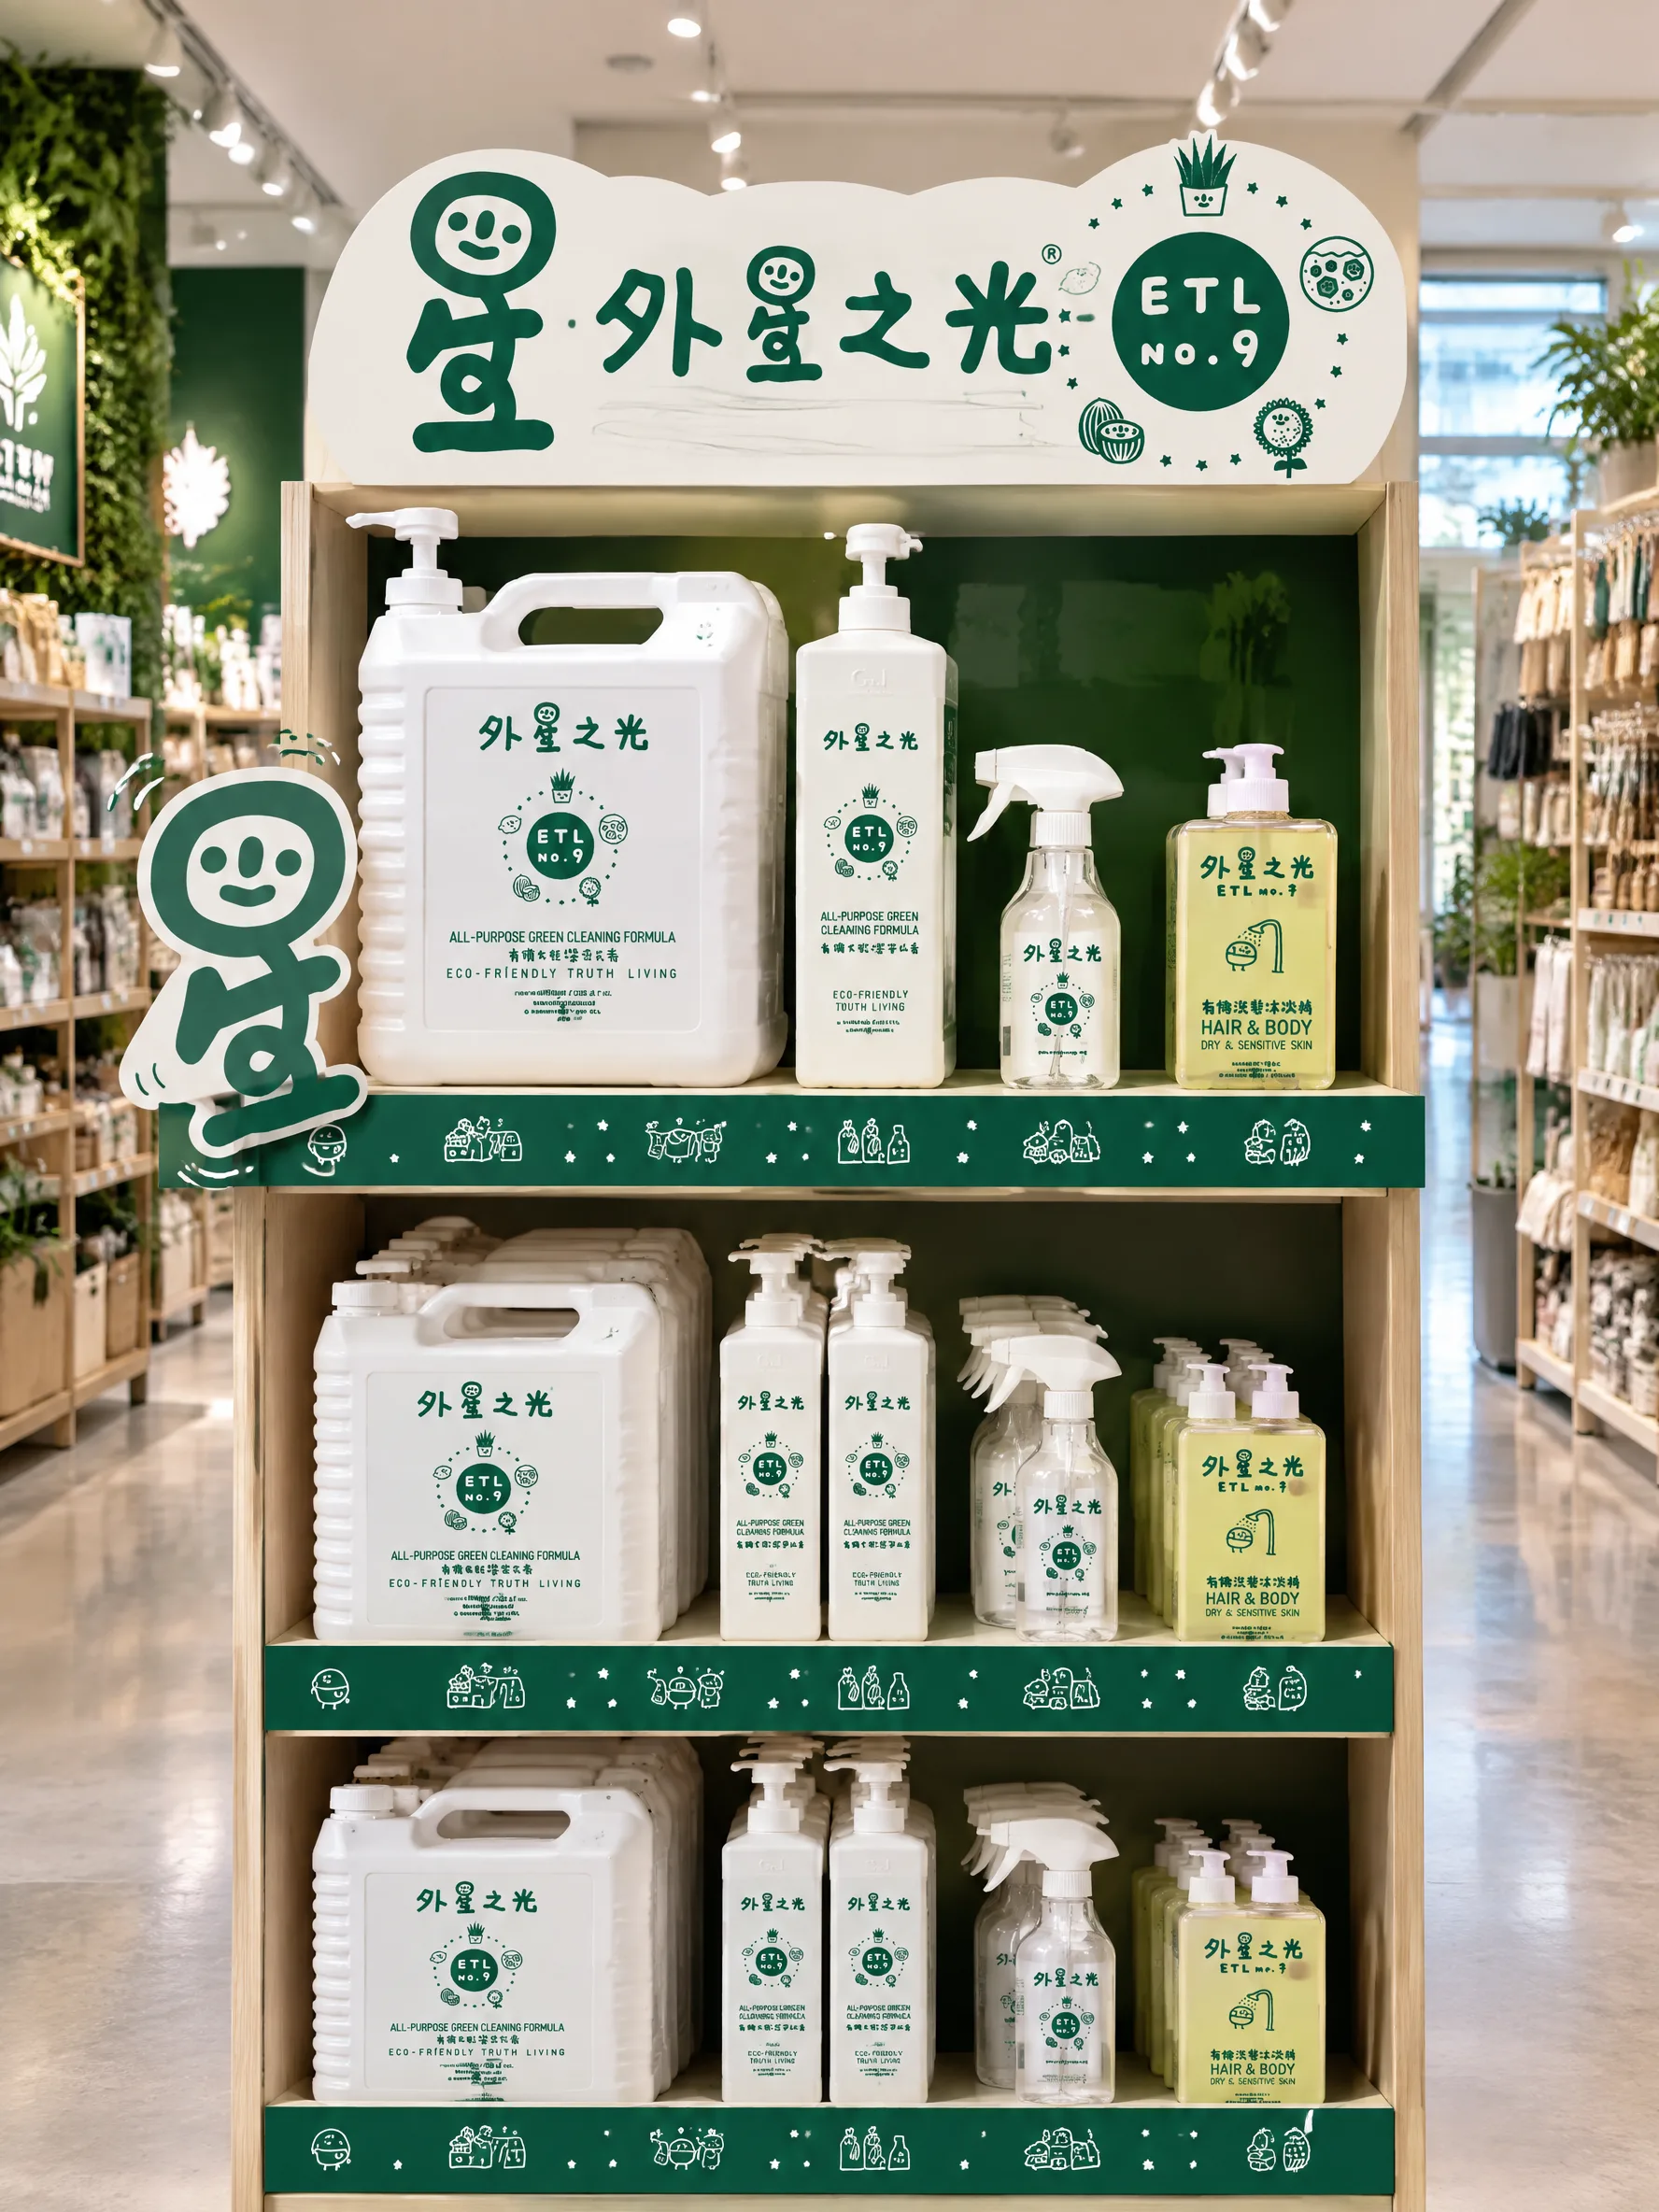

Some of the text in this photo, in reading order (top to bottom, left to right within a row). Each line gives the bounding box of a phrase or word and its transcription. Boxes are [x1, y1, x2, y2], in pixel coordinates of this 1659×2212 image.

[1141, 276, 1261, 316] ETL
[537, 829, 584, 844] ETL
[852, 826, 886, 838] ETL
[1216, 884, 1253, 897] ETL
[820, 911, 919, 922] ALL-PURPOSE GREEN
[449, 930, 676, 943] ALL-PURPOSE GREEN CLEANING FORMULA
[567, 968, 614, 979] TRUTH
[628, 968, 677, 979] LIVING
[832, 989, 909, 1000] ECO-FRIENDLY
[1050, 1000, 1073, 1009] ETL
[1201, 1018, 1312, 1036] HAIR & BODY
[1200, 1040, 1312, 1051] DRY & SENSITIVE SKIN
[759, 1459, 782, 1468] ETL
[865, 1460, 888, 1469] ETL
[465, 1475, 503, 1487] ETL
[1217, 1481, 1250, 1493] ETL
[390, 1550, 581, 1561] ALL-PURPOSE GREEN CLEANING FORMULA
[489, 1579, 529, 1588] TRUTH
[539, 1579, 581, 1588] LIVING
[1206, 1591, 1300, 1606] HAIR & BODY
[1205, 1608, 1223, 1617] DRY
[1236, 1608, 1277, 1617] SENSITIVE
[1281, 1609, 1300, 1617] SKIN
[458, 1959, 491, 1969] ETL
[1219, 1963, 1250, 1974] ETL
[390, 2022, 565, 2033] ALL-PURPOSE GREEN CLEANING FORMULA
[481, 2048, 518, 2057] TRUTH
[526, 2048, 565, 2057] LIVING
[1211, 2063, 1296, 2076] HAIR & BODY
[1210, 2077, 1226, 2086] DRY
